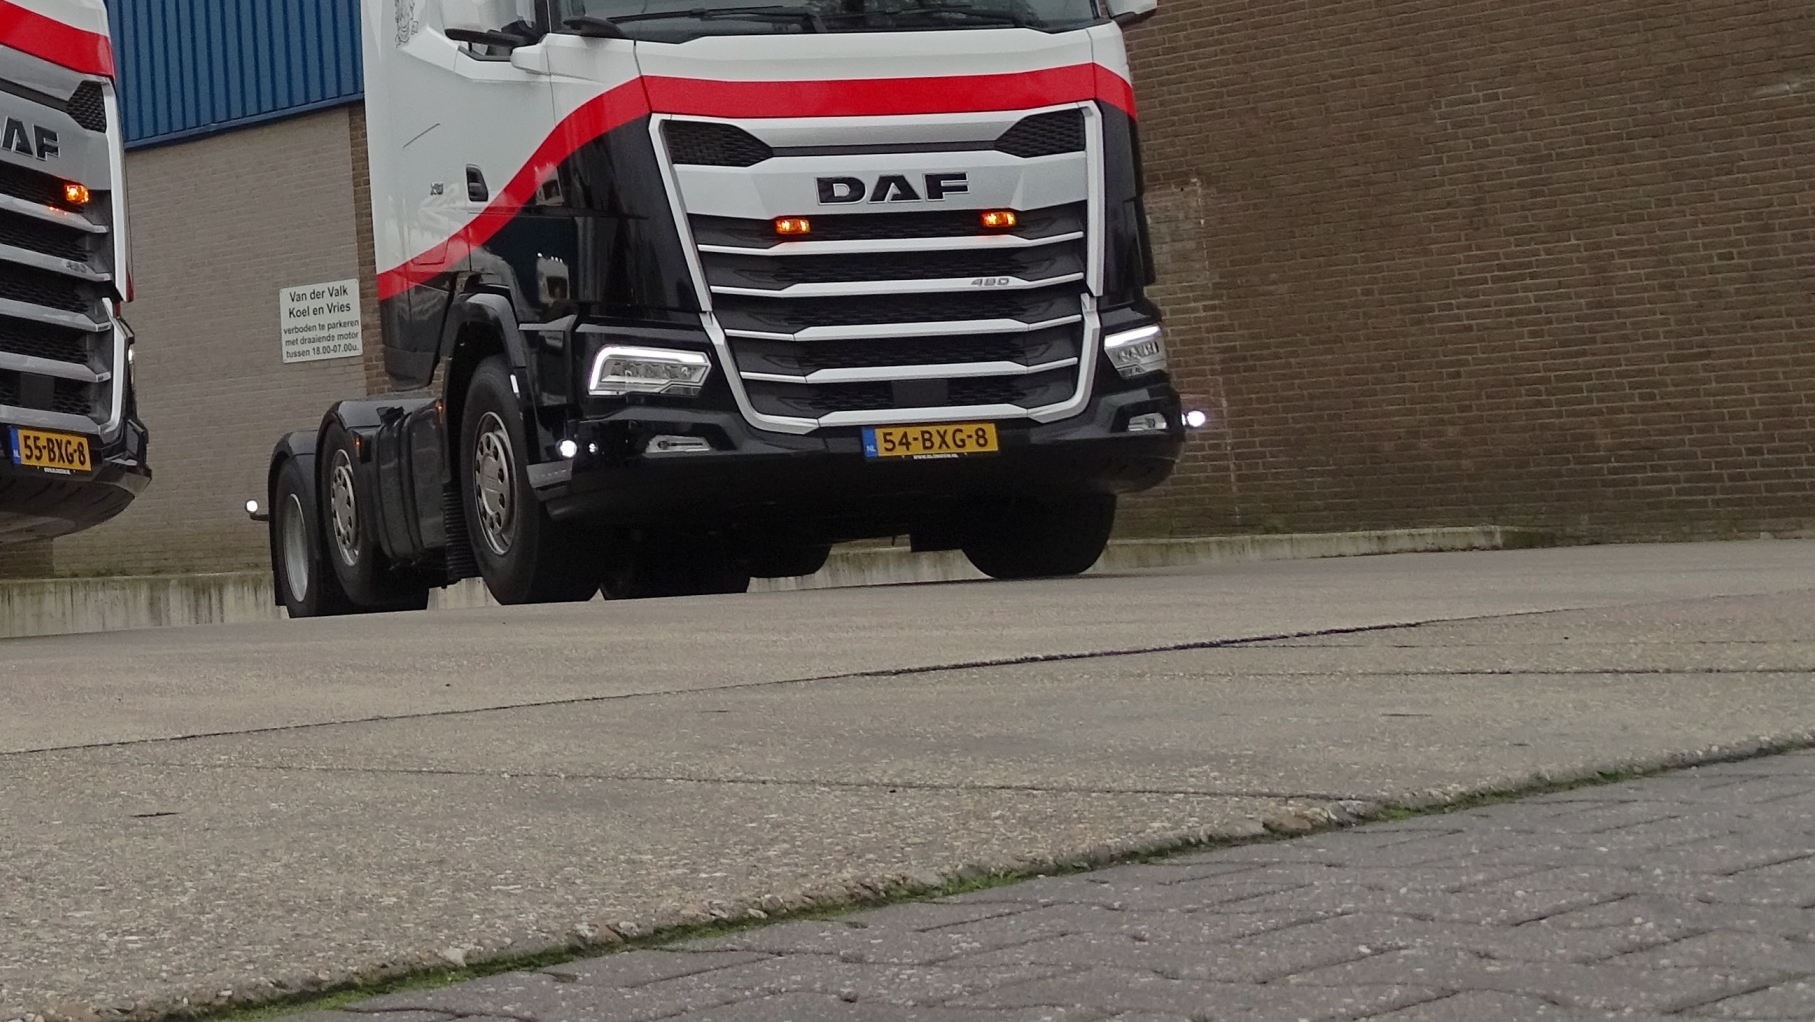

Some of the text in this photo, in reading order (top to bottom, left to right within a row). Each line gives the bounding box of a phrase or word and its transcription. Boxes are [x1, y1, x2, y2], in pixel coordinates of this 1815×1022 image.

[815, 172, 970, 205] DAF
[289, 285, 349, 302] Van der Valk
[288, 302, 351, 318] Koel en Vries
[283, 320, 359, 335] verboden te parkeren
[285, 331, 359, 346] met draaiende motor
[286, 350, 310, 358] tussen
[882, 427, 989, 452] 54-BXG-8
[23, 435, 86, 466] 55-BXG-8
